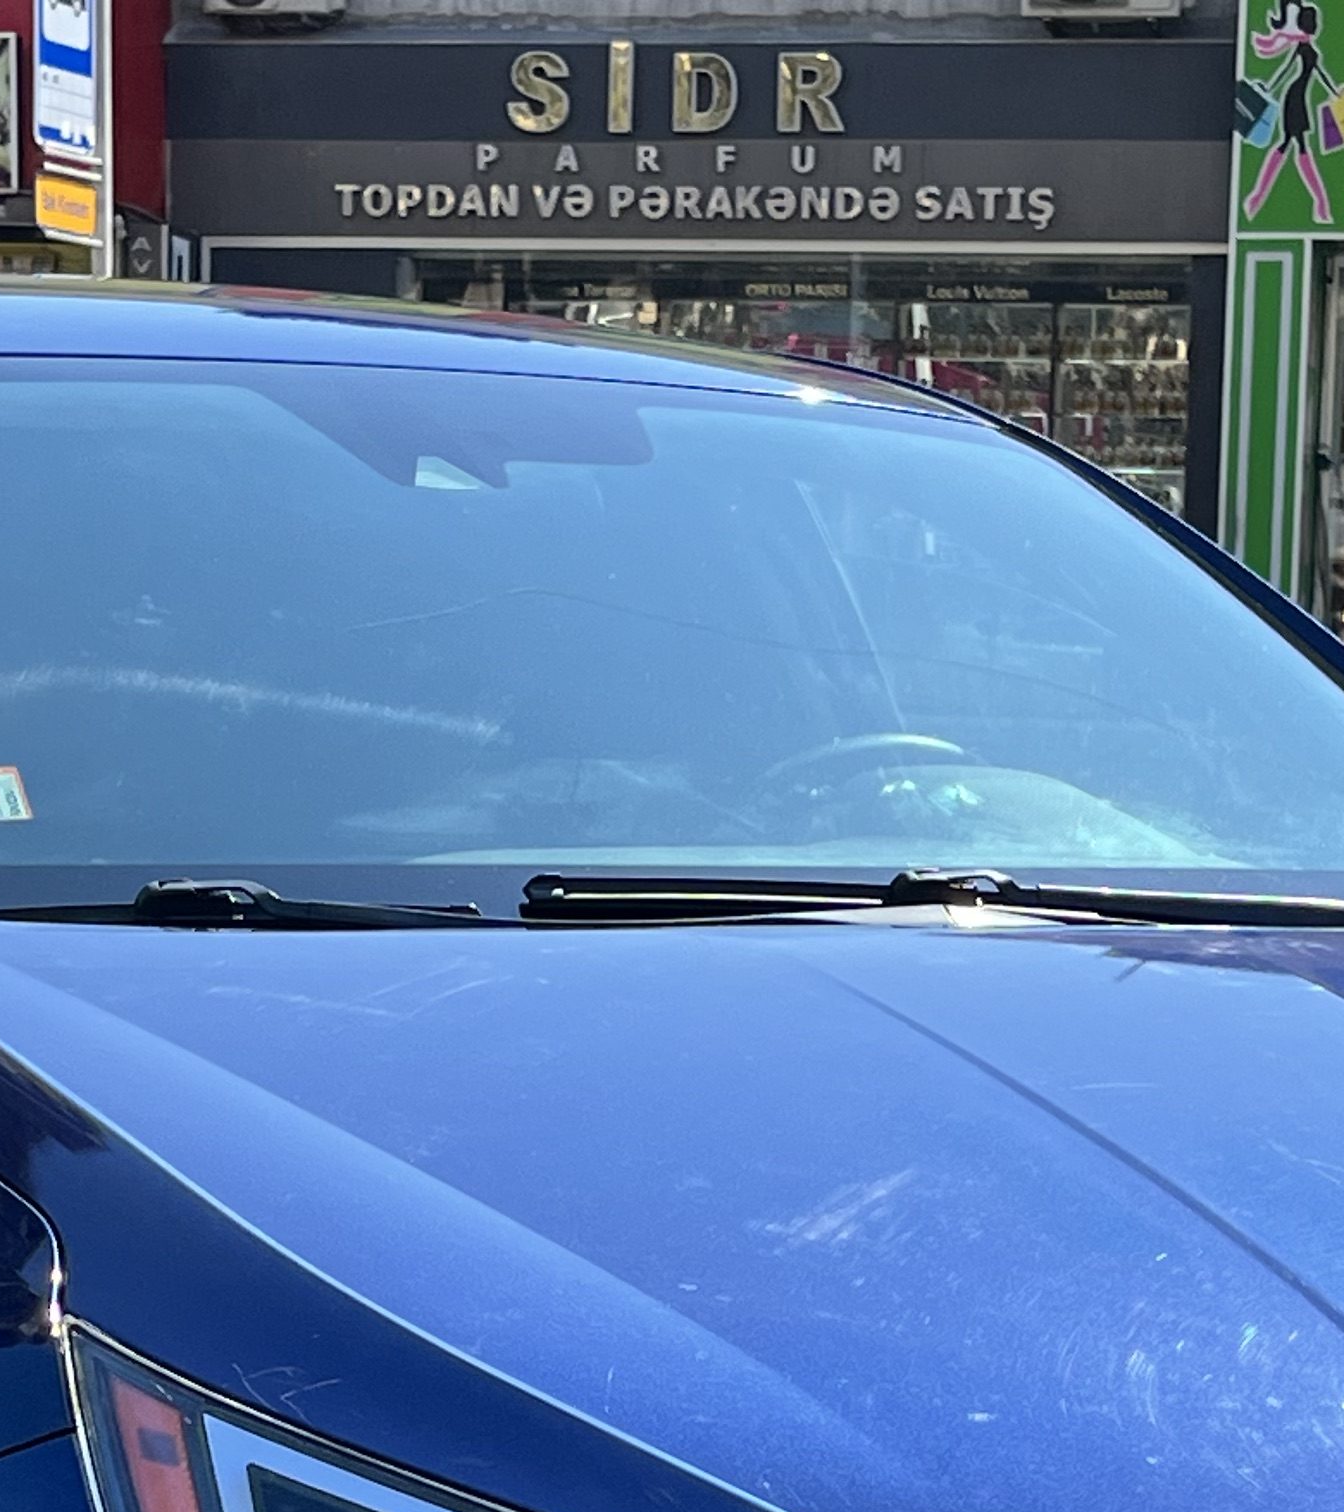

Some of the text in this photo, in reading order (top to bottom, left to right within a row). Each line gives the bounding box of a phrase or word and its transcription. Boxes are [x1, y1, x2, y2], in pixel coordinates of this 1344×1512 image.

[476, 144, 902, 173] PARFUM
[334, 183, 1056, 230] TOPDAN VƏ PƏRAKƏNDƏ SATIŞ
